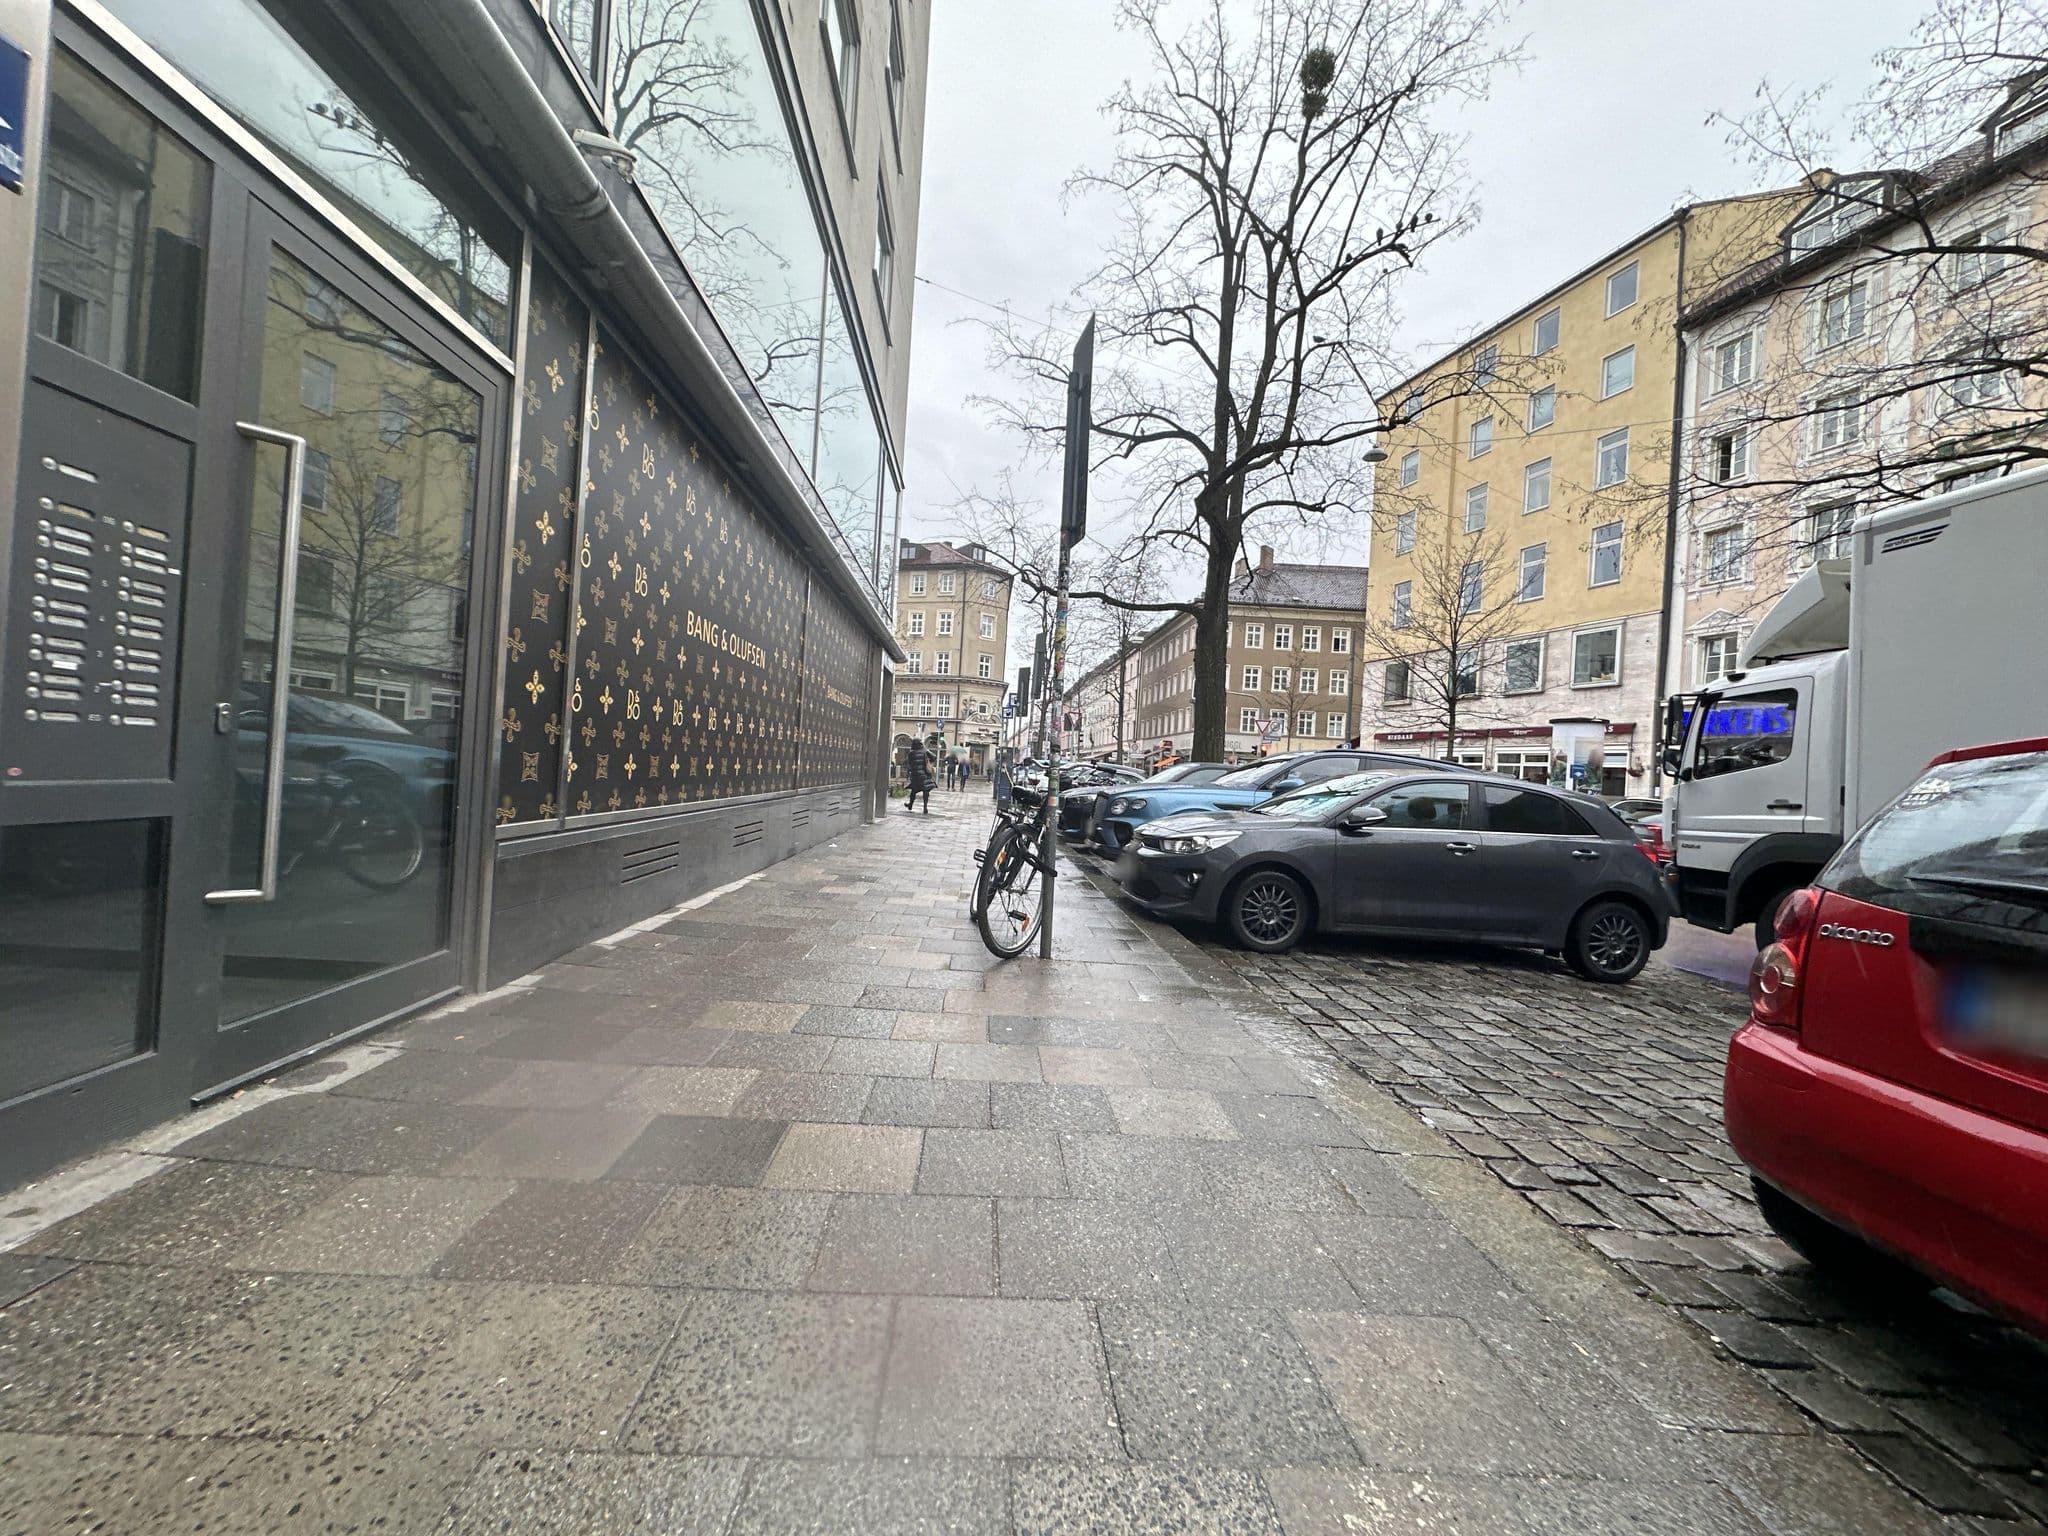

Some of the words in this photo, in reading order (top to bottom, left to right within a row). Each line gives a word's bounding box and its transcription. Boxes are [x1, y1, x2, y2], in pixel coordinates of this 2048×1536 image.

[687, 610, 719, 647] BANG
[721, 628, 728, 651] &
[729, 633, 766, 669] OLUFSEN
[1818, 922, 1895, 946] picanto
